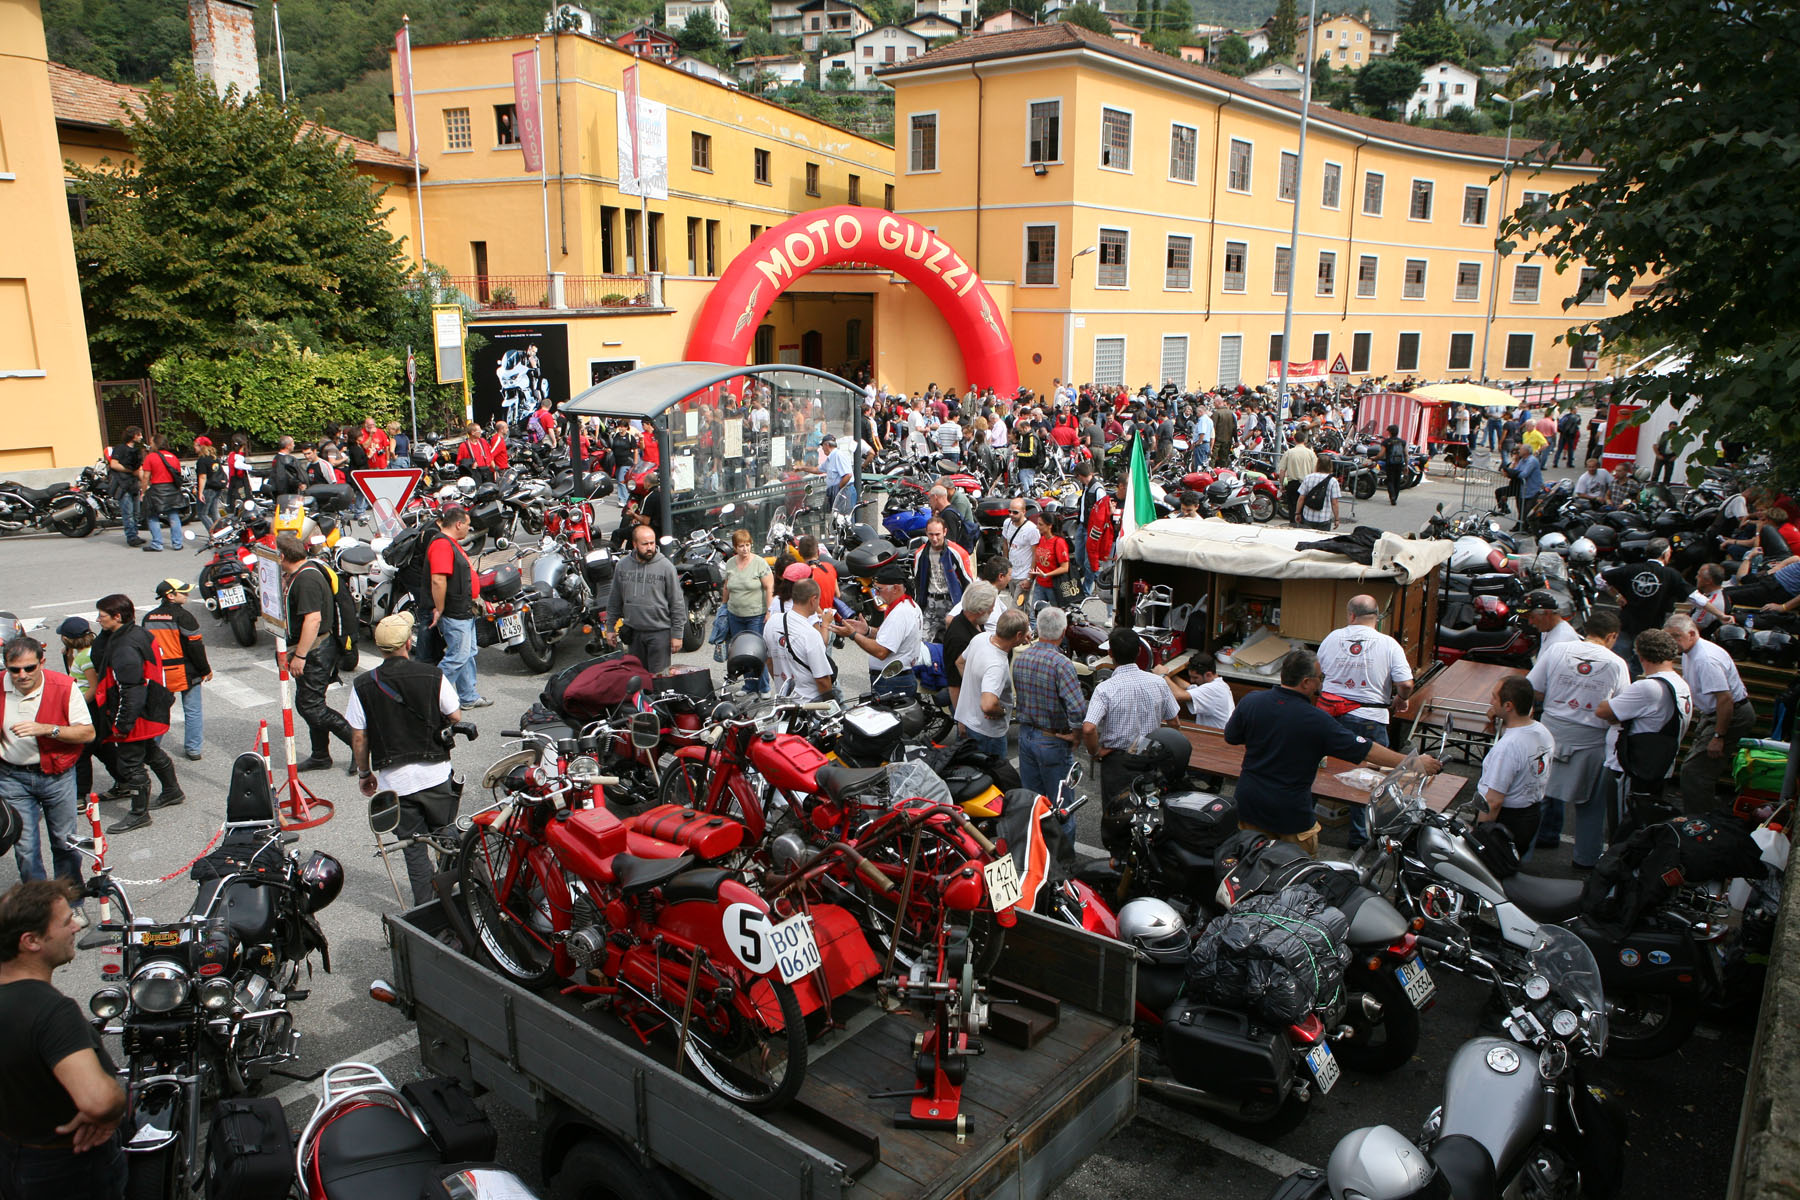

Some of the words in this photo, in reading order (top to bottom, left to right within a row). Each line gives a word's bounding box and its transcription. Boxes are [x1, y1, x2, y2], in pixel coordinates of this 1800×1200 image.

[755, 214, 863, 290] MOTO
[877, 215, 978, 298] GUZZI
[502, 617, 513, 627] RV
[509, 625, 522, 635] 439
[1002, 878, 1018, 901] TV
[740, 909, 764, 965] 5
[780, 942, 818, 978] 0610
[1402, 964, 1416, 981] BV
